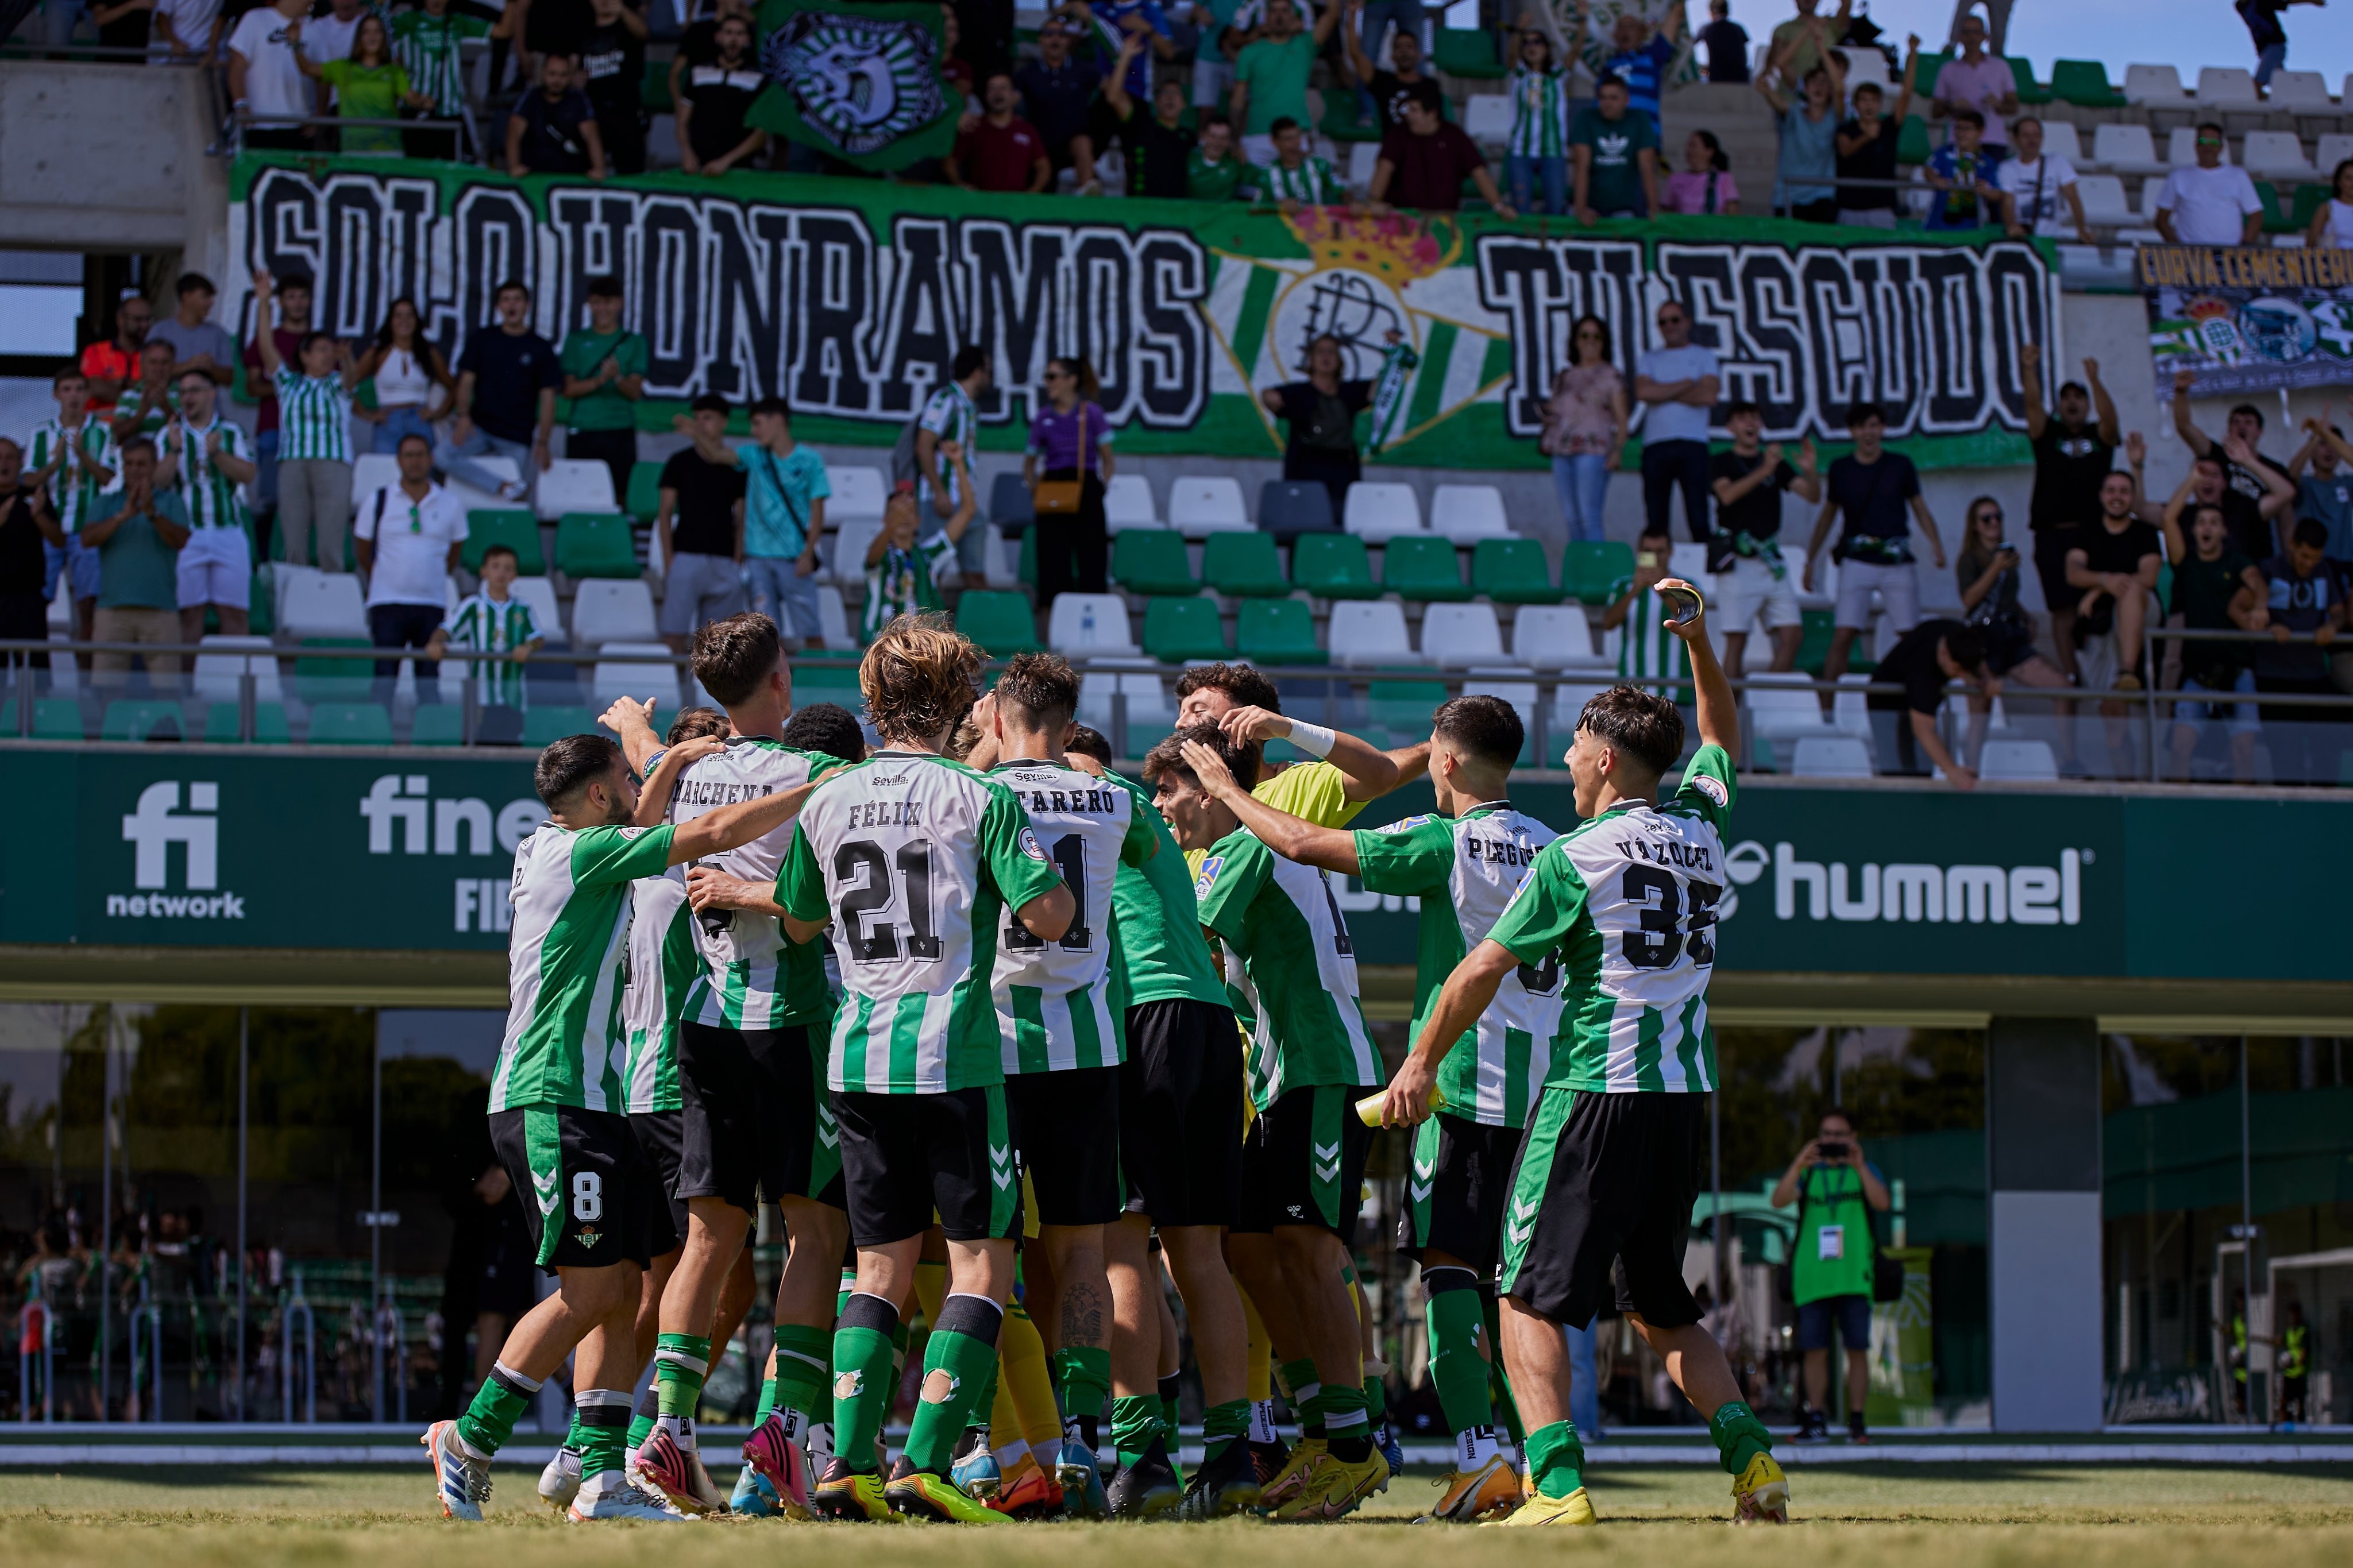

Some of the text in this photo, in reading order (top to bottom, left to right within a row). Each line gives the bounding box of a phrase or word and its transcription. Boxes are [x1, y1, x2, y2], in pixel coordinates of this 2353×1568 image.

[2140, 248, 2221, 287] CURVA
[240, 167, 2059, 441] SOLO HONRAMOS TU ESCUDO
[122, 781, 219, 890] fi
[848, 800, 923, 831] FÉLIX
[107, 891, 245, 920] network
[834, 839, 944, 964] 21
[1774, 841, 2081, 925] hummel
[573, 1172, 603, 1222] 8
